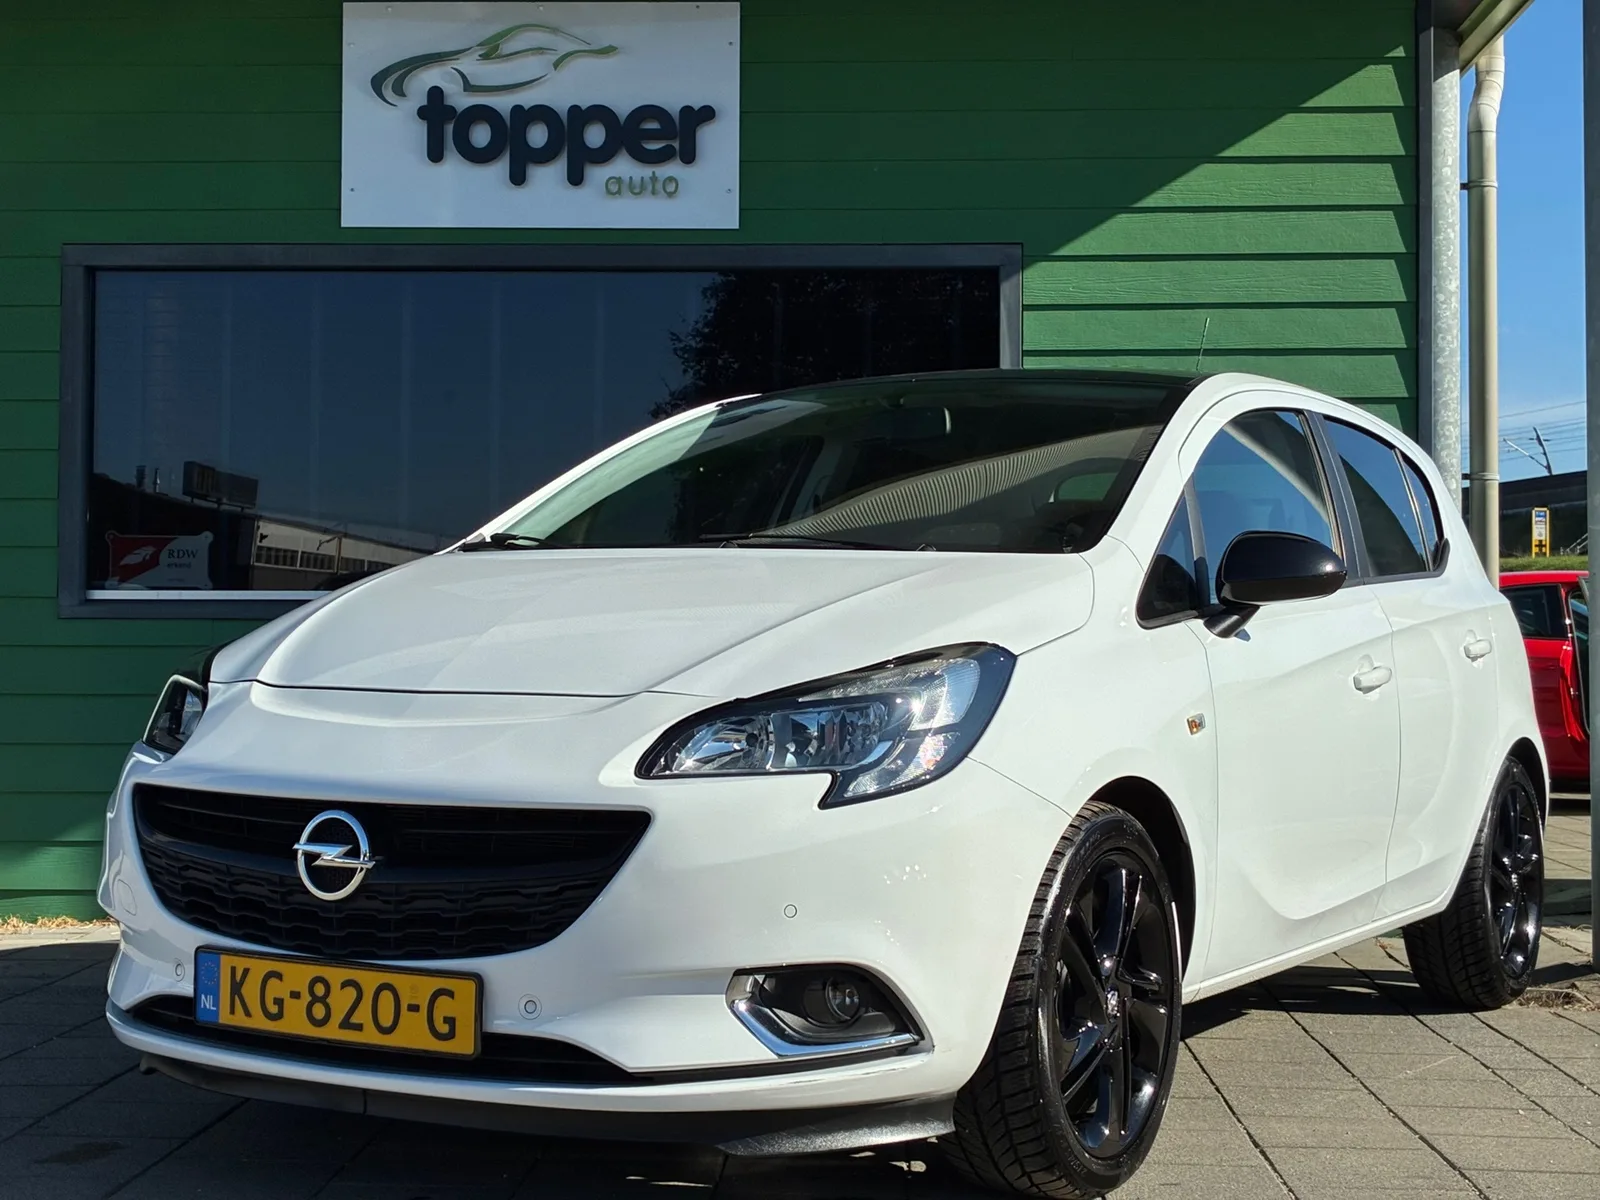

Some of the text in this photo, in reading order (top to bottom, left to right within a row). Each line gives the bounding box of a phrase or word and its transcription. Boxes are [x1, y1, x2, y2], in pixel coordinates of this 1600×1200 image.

[417, 85, 716, 187] topper
[605, 171, 680, 198] auto
[167, 548, 199, 559] RDW
[200, 993, 217, 1011] NL
[228, 965, 457, 1042] KG-820-G
